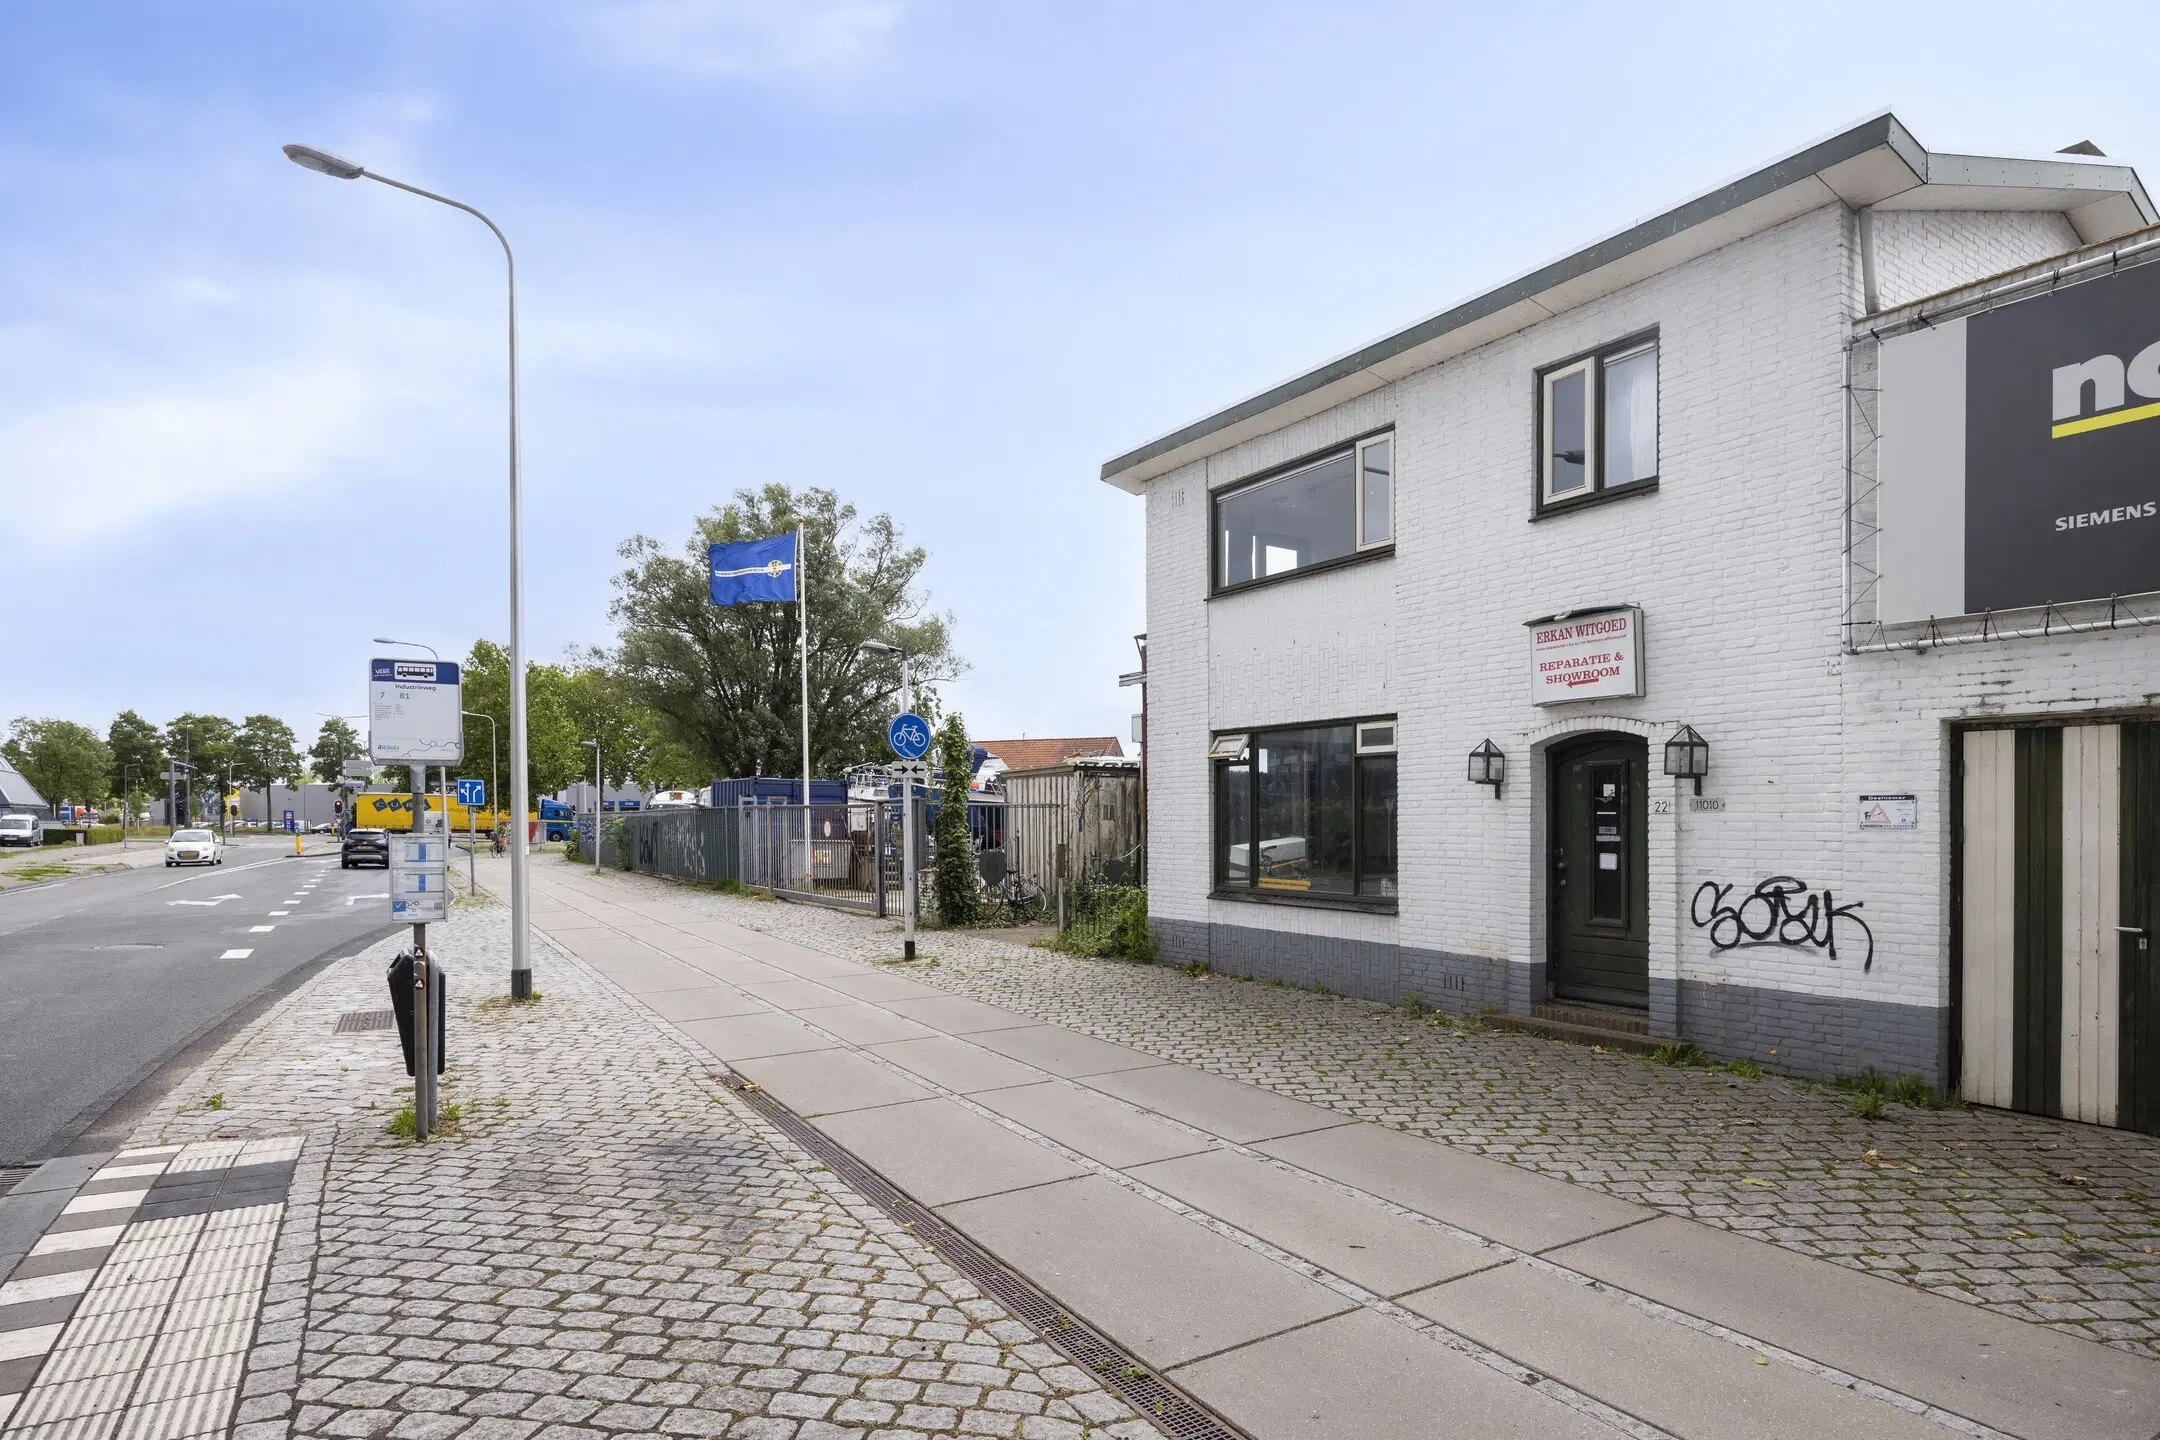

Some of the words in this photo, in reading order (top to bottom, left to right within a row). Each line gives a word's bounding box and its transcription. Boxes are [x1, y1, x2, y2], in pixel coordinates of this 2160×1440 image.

[2055, 501, 2157, 531] SIEMENS
[1536, 627, 1574, 644] ERKAN
[1575, 618, 1627, 637] WITGOED
[1539, 653, 1611, 672] REPARATIE
[1614, 651, 1625, 661] &
[1546, 666, 1620, 684] SHOWROOM
[1655, 802, 1668, 812] 22
[1696, 800, 1719, 810] 11010
